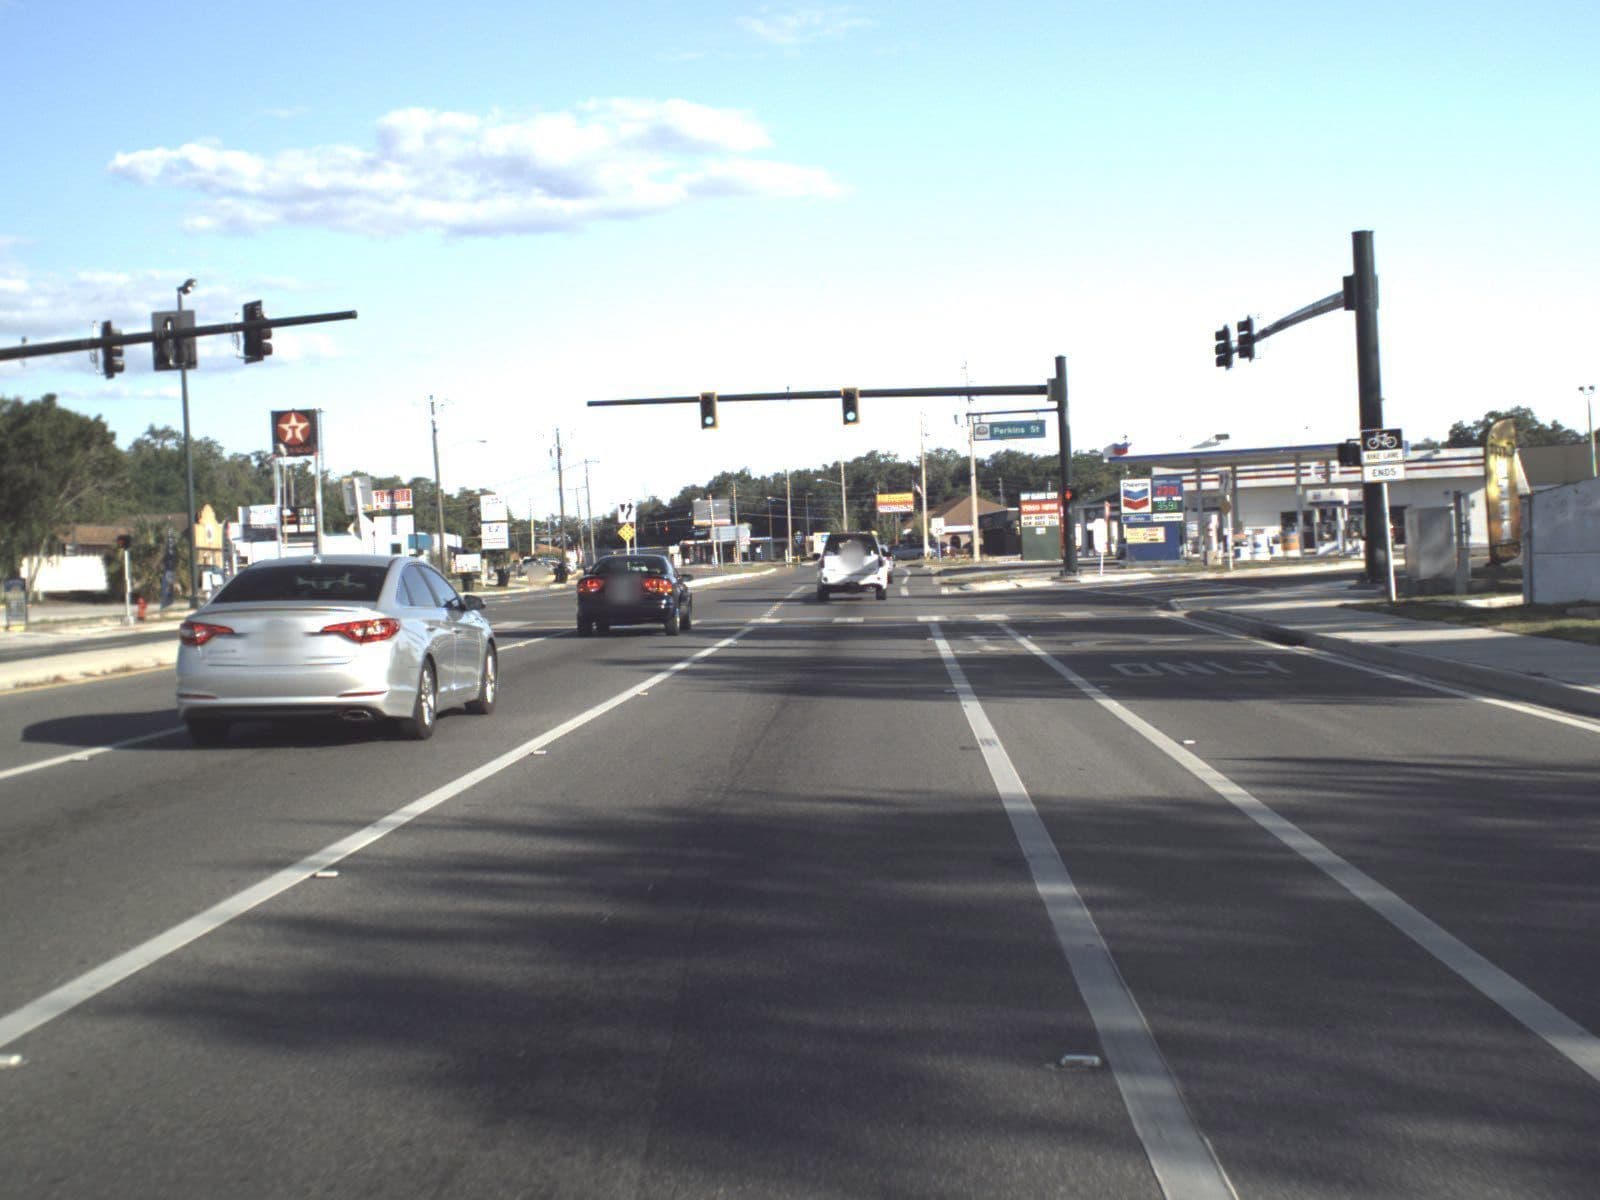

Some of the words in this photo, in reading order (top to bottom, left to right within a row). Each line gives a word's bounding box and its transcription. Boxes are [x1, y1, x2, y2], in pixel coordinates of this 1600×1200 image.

[993, 426, 1026, 436] Perkins
[1030, 424, 1041, 433] St
[1372, 467, 1397, 477] ENDS
[1109, 660, 1293, 676] ONLY
